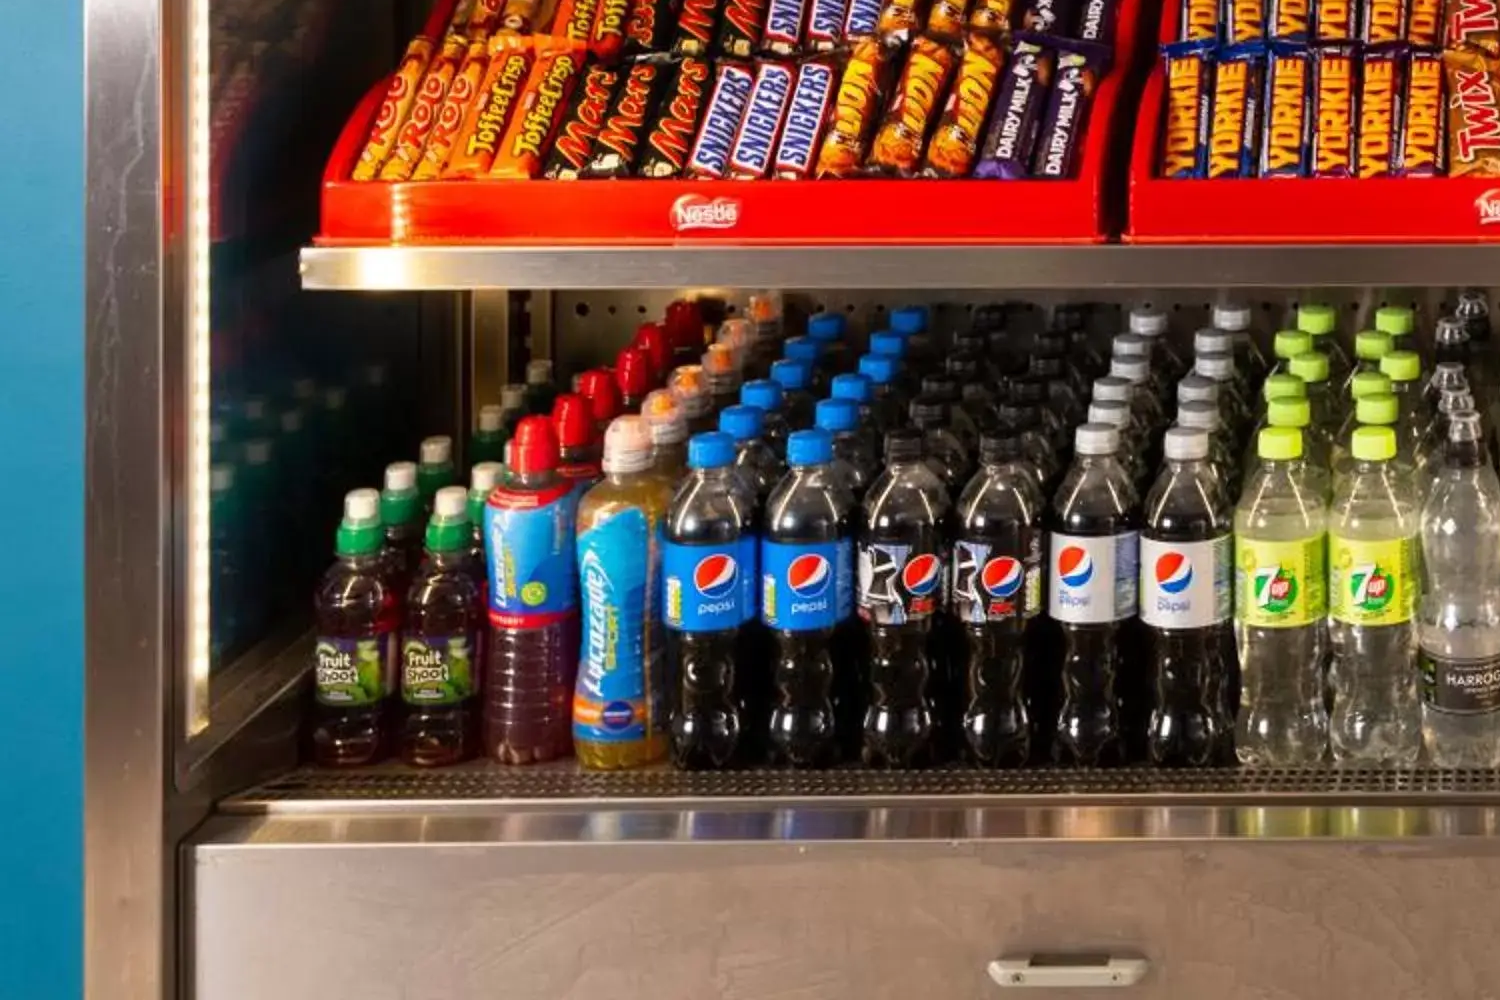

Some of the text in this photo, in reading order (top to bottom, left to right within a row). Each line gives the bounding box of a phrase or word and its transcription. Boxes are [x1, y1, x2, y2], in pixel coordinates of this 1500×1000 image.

[1082, 0, 1105, 39] DAIRY
[556, 65, 619, 169] Mars
[598, 64, 656, 160] Mars
[648, 58, 709, 170] Mars
[694, 66, 753, 171] SNICKERS
[735, 66, 790, 170] SNICKERS
[778, 64, 830, 165] SNICKERS
[836, 57, 874, 136] LION
[902, 54, 945, 133] LION
[958, 52, 999, 138] LION
[996, 77, 1031, 159] DAIRY MILK
[1046, 94, 1078, 176] DAIRY MILK
[1167, 59, 1199, 175] YORKIE
[1211, 62, 1248, 177] YORKIE
[1269, 59, 1304, 168] YORKIE
[1316, 60, 1352, 170] YORKIE
[1361, 62, 1395, 178] YORKIE
[1404, 60, 1441, 167] YORKIE
[697, 600, 736, 616] pepsi
[791, 600, 828, 615] pepsi
[404, 664, 449, 684] Shoot
[407, 648, 442, 666] Fruit
